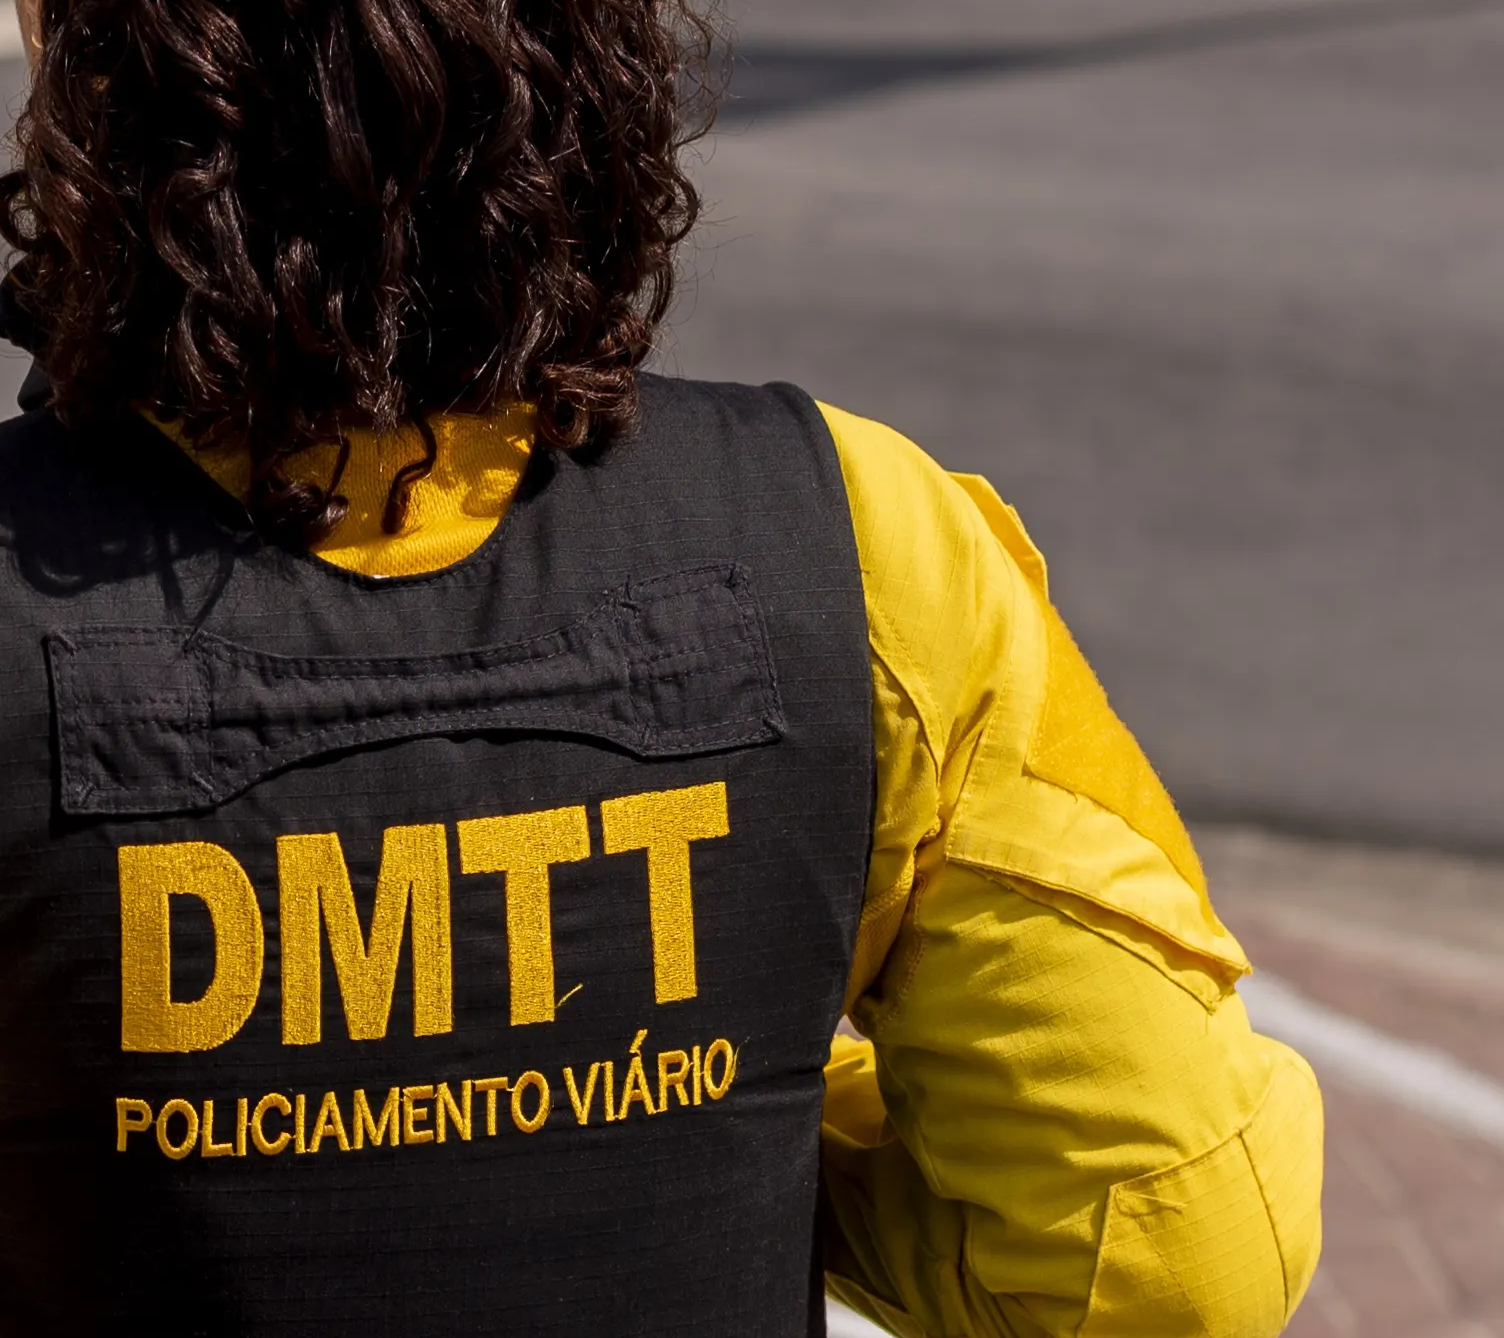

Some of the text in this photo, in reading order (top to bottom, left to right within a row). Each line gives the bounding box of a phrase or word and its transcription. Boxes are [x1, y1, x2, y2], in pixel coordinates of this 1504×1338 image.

[117, 781, 731, 1053] DMTT
[116, 1029, 738, 1160] POLICIAMENTO VIÁRIO
